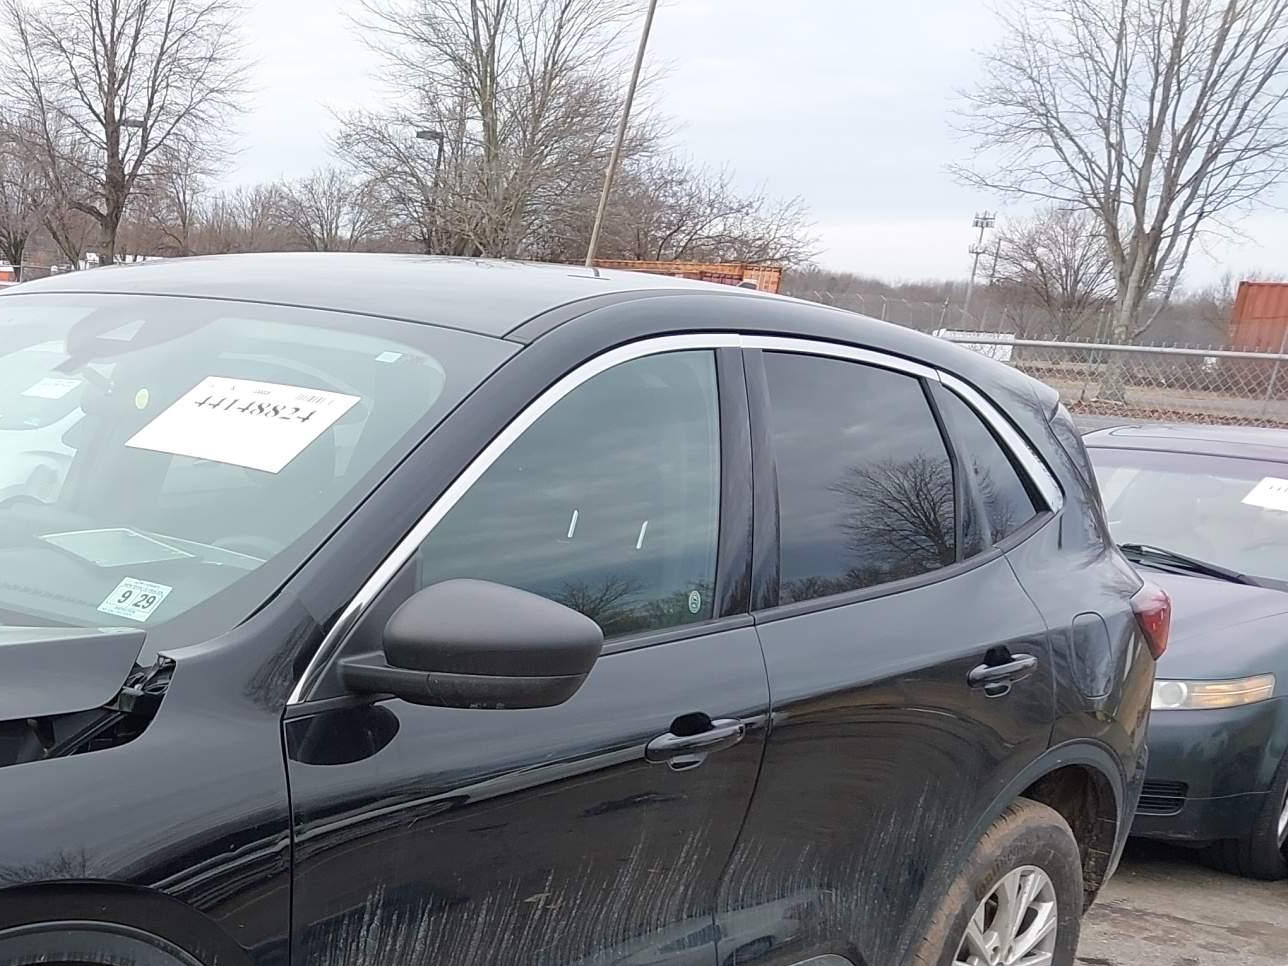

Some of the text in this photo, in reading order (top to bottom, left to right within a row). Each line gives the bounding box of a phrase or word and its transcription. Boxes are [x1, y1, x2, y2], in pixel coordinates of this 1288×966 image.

[194, 395, 317, 423] 44148824
[117, 590, 157, 609] 9 29
